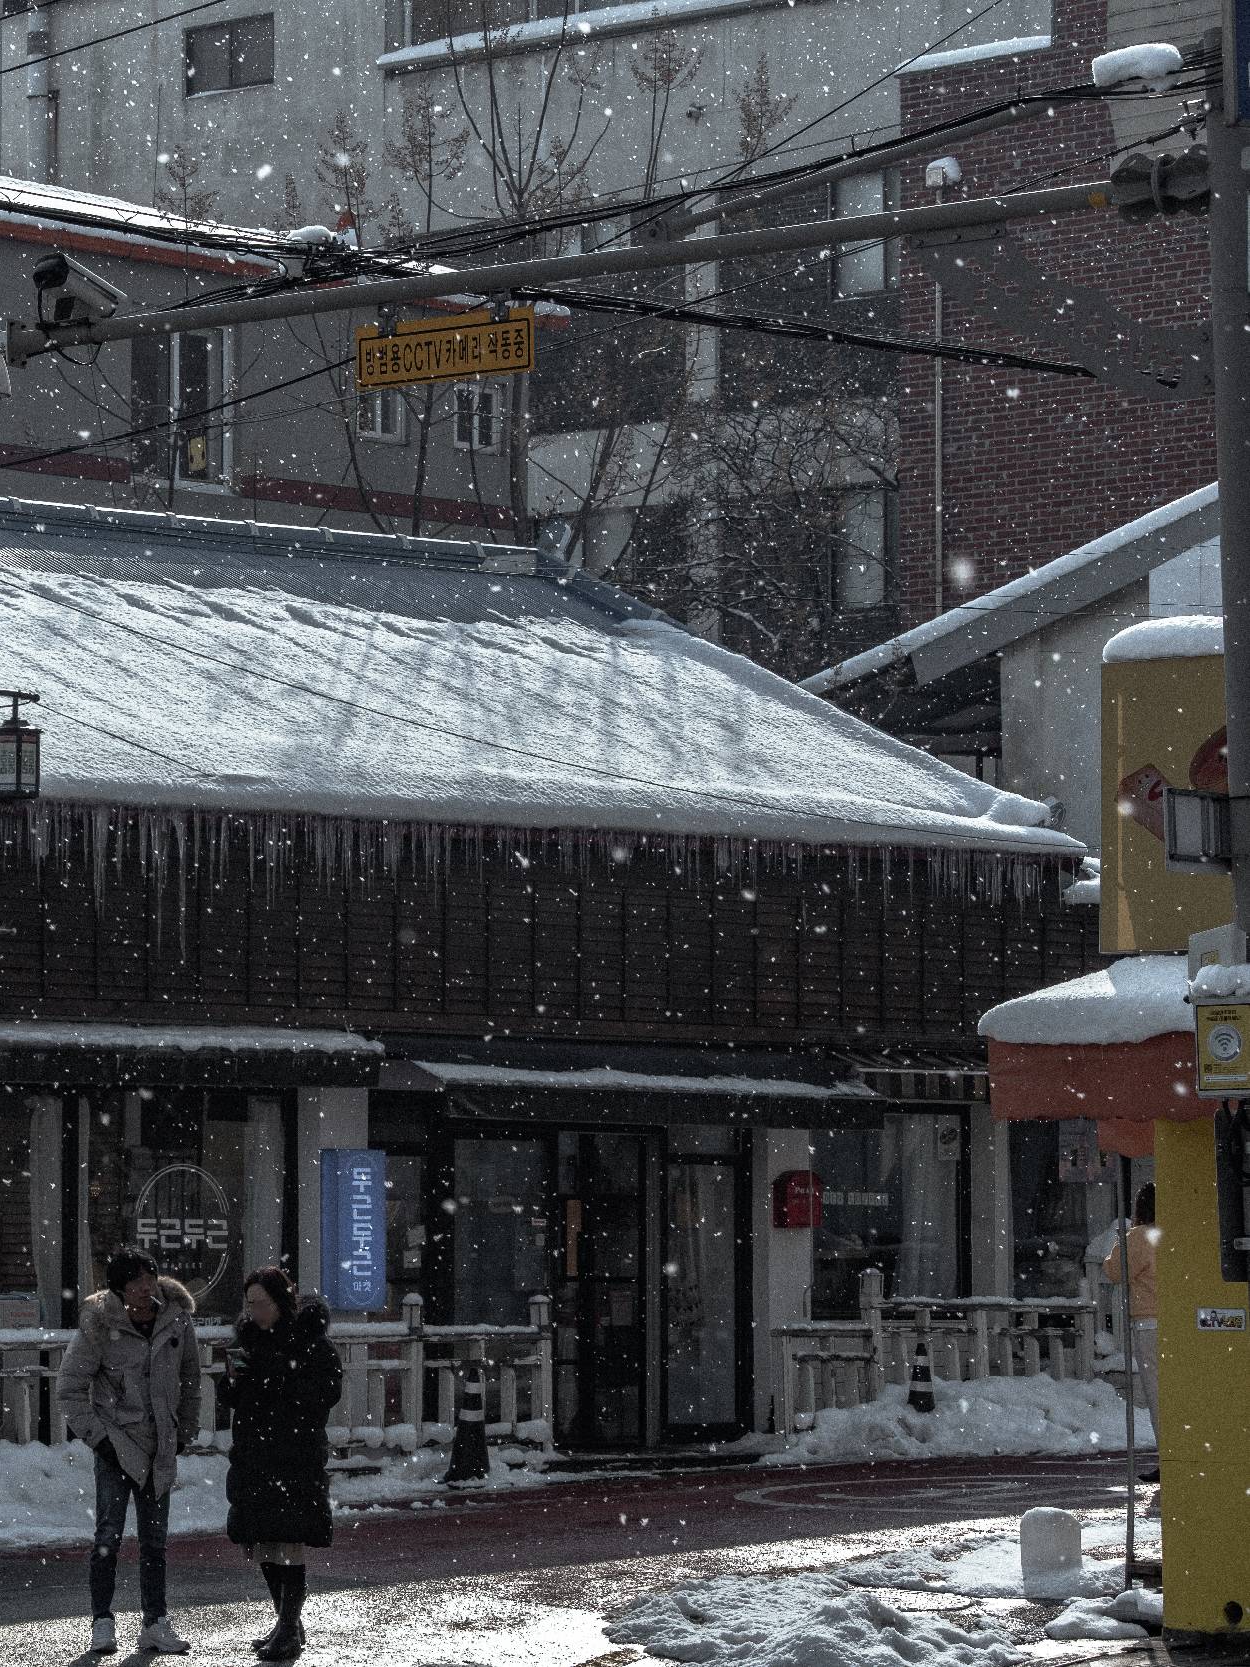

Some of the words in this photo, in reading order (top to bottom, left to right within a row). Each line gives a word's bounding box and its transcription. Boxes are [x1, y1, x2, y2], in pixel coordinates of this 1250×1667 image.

[487, 328, 526, 361] 작동중
[136, 1218, 229, 1249] 두근두근
[352, 1167, 373, 1276] 두근두근
[353, 1281, 372, 1292] 마켓
